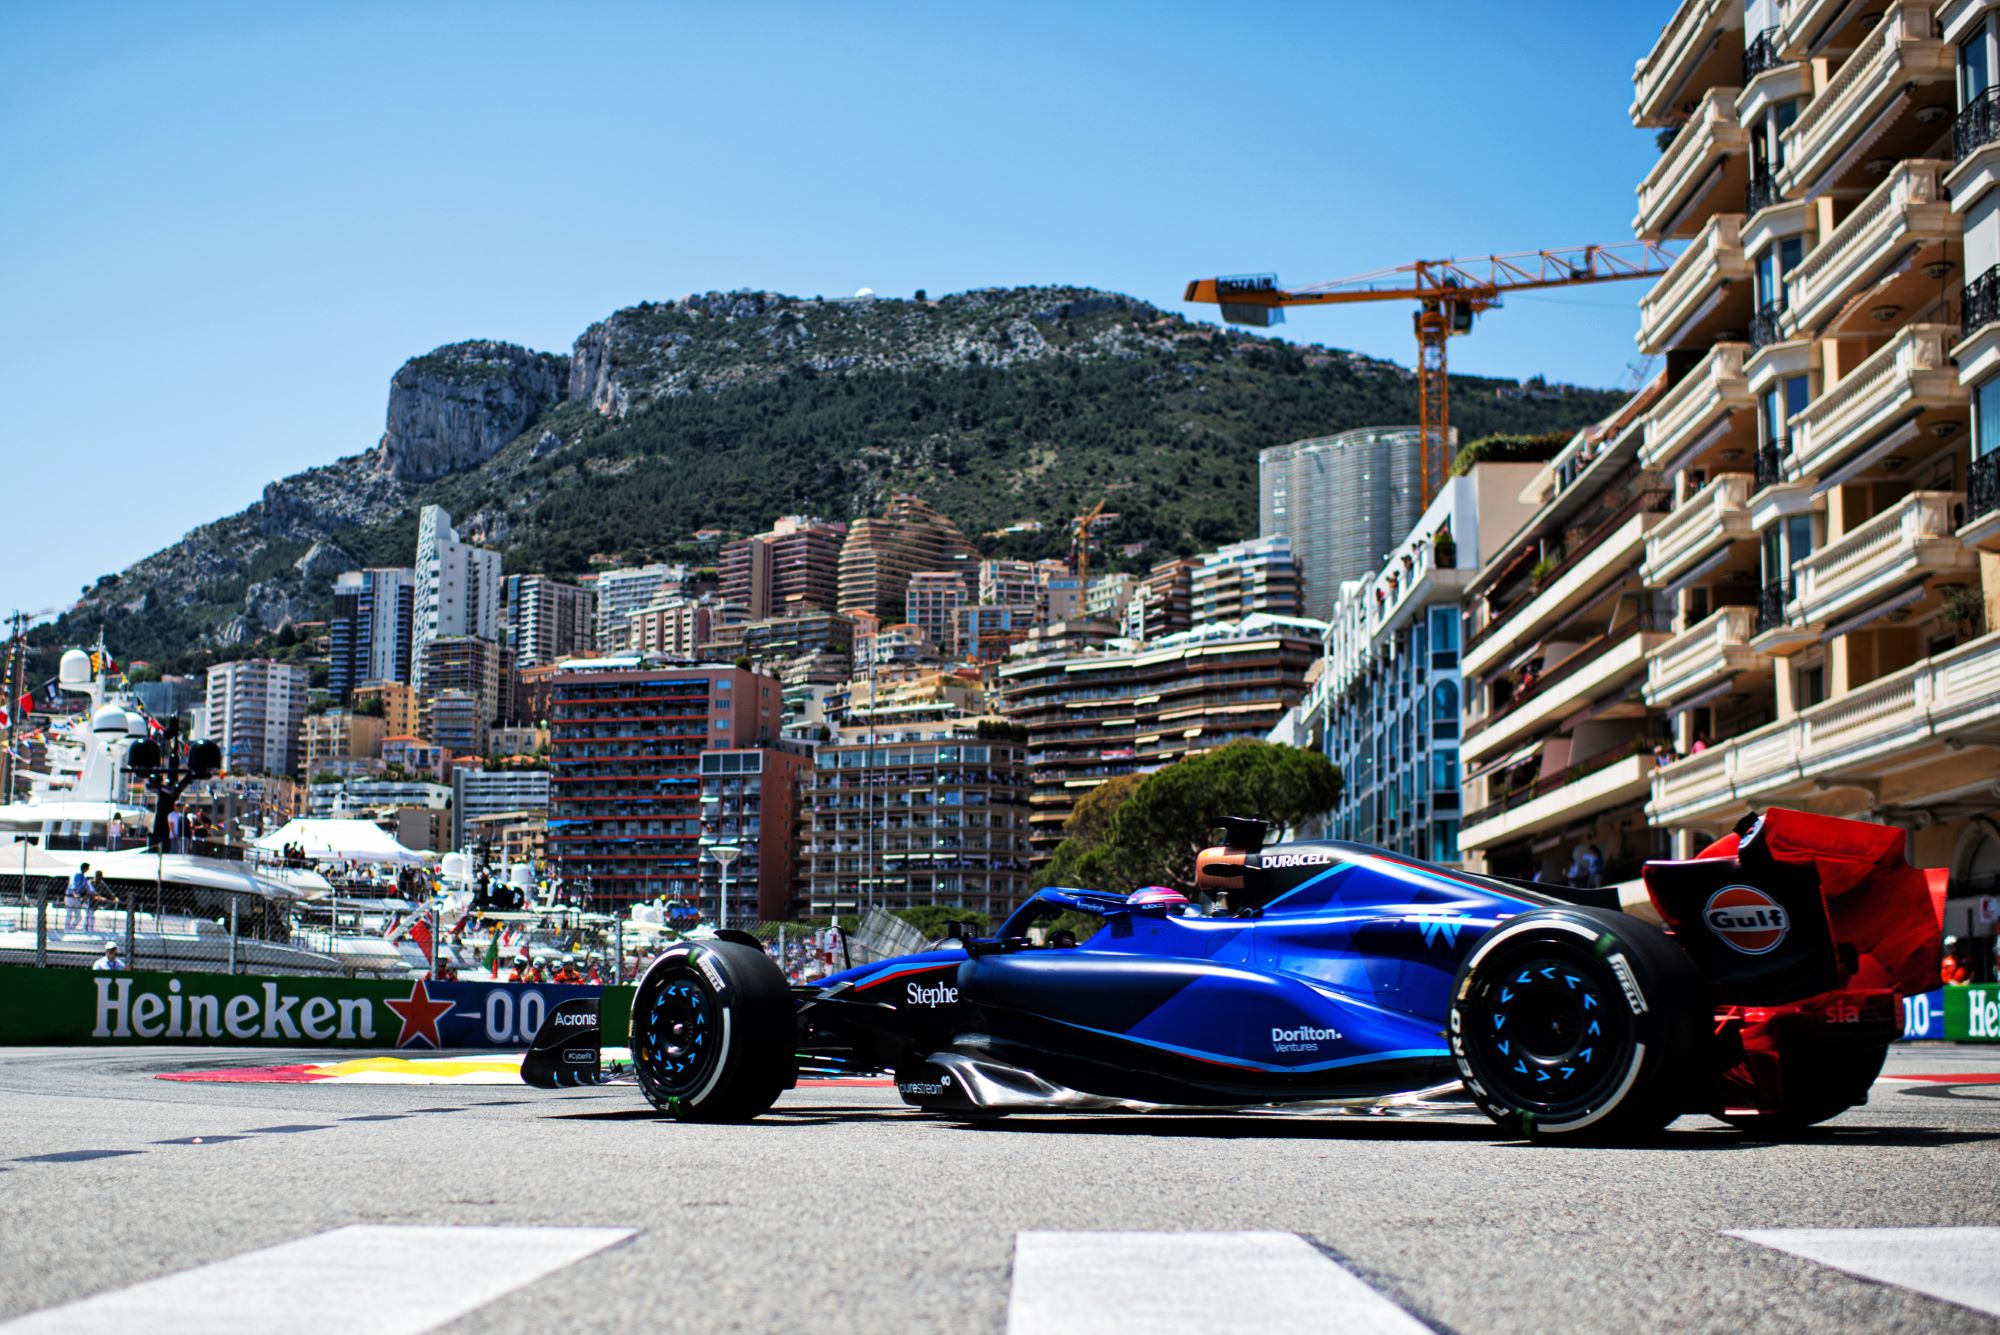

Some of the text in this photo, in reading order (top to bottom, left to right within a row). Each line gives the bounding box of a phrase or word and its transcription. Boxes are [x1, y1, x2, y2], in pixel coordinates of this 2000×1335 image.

[1262, 854, 1331, 869] DURACELL
[1709, 909, 1783, 929] Gulf
[907, 981, 959, 1008] Stephe
[1607, 952, 1649, 1015] PIRELLI
[92, 977, 377, 1040] Heineken
[555, 1012, 597, 1026] Acronis
[1825, 1000, 1860, 1023] sia
[1968, 990, 2000, 1037] He
[1273, 1043, 1319, 1053] Ventures
